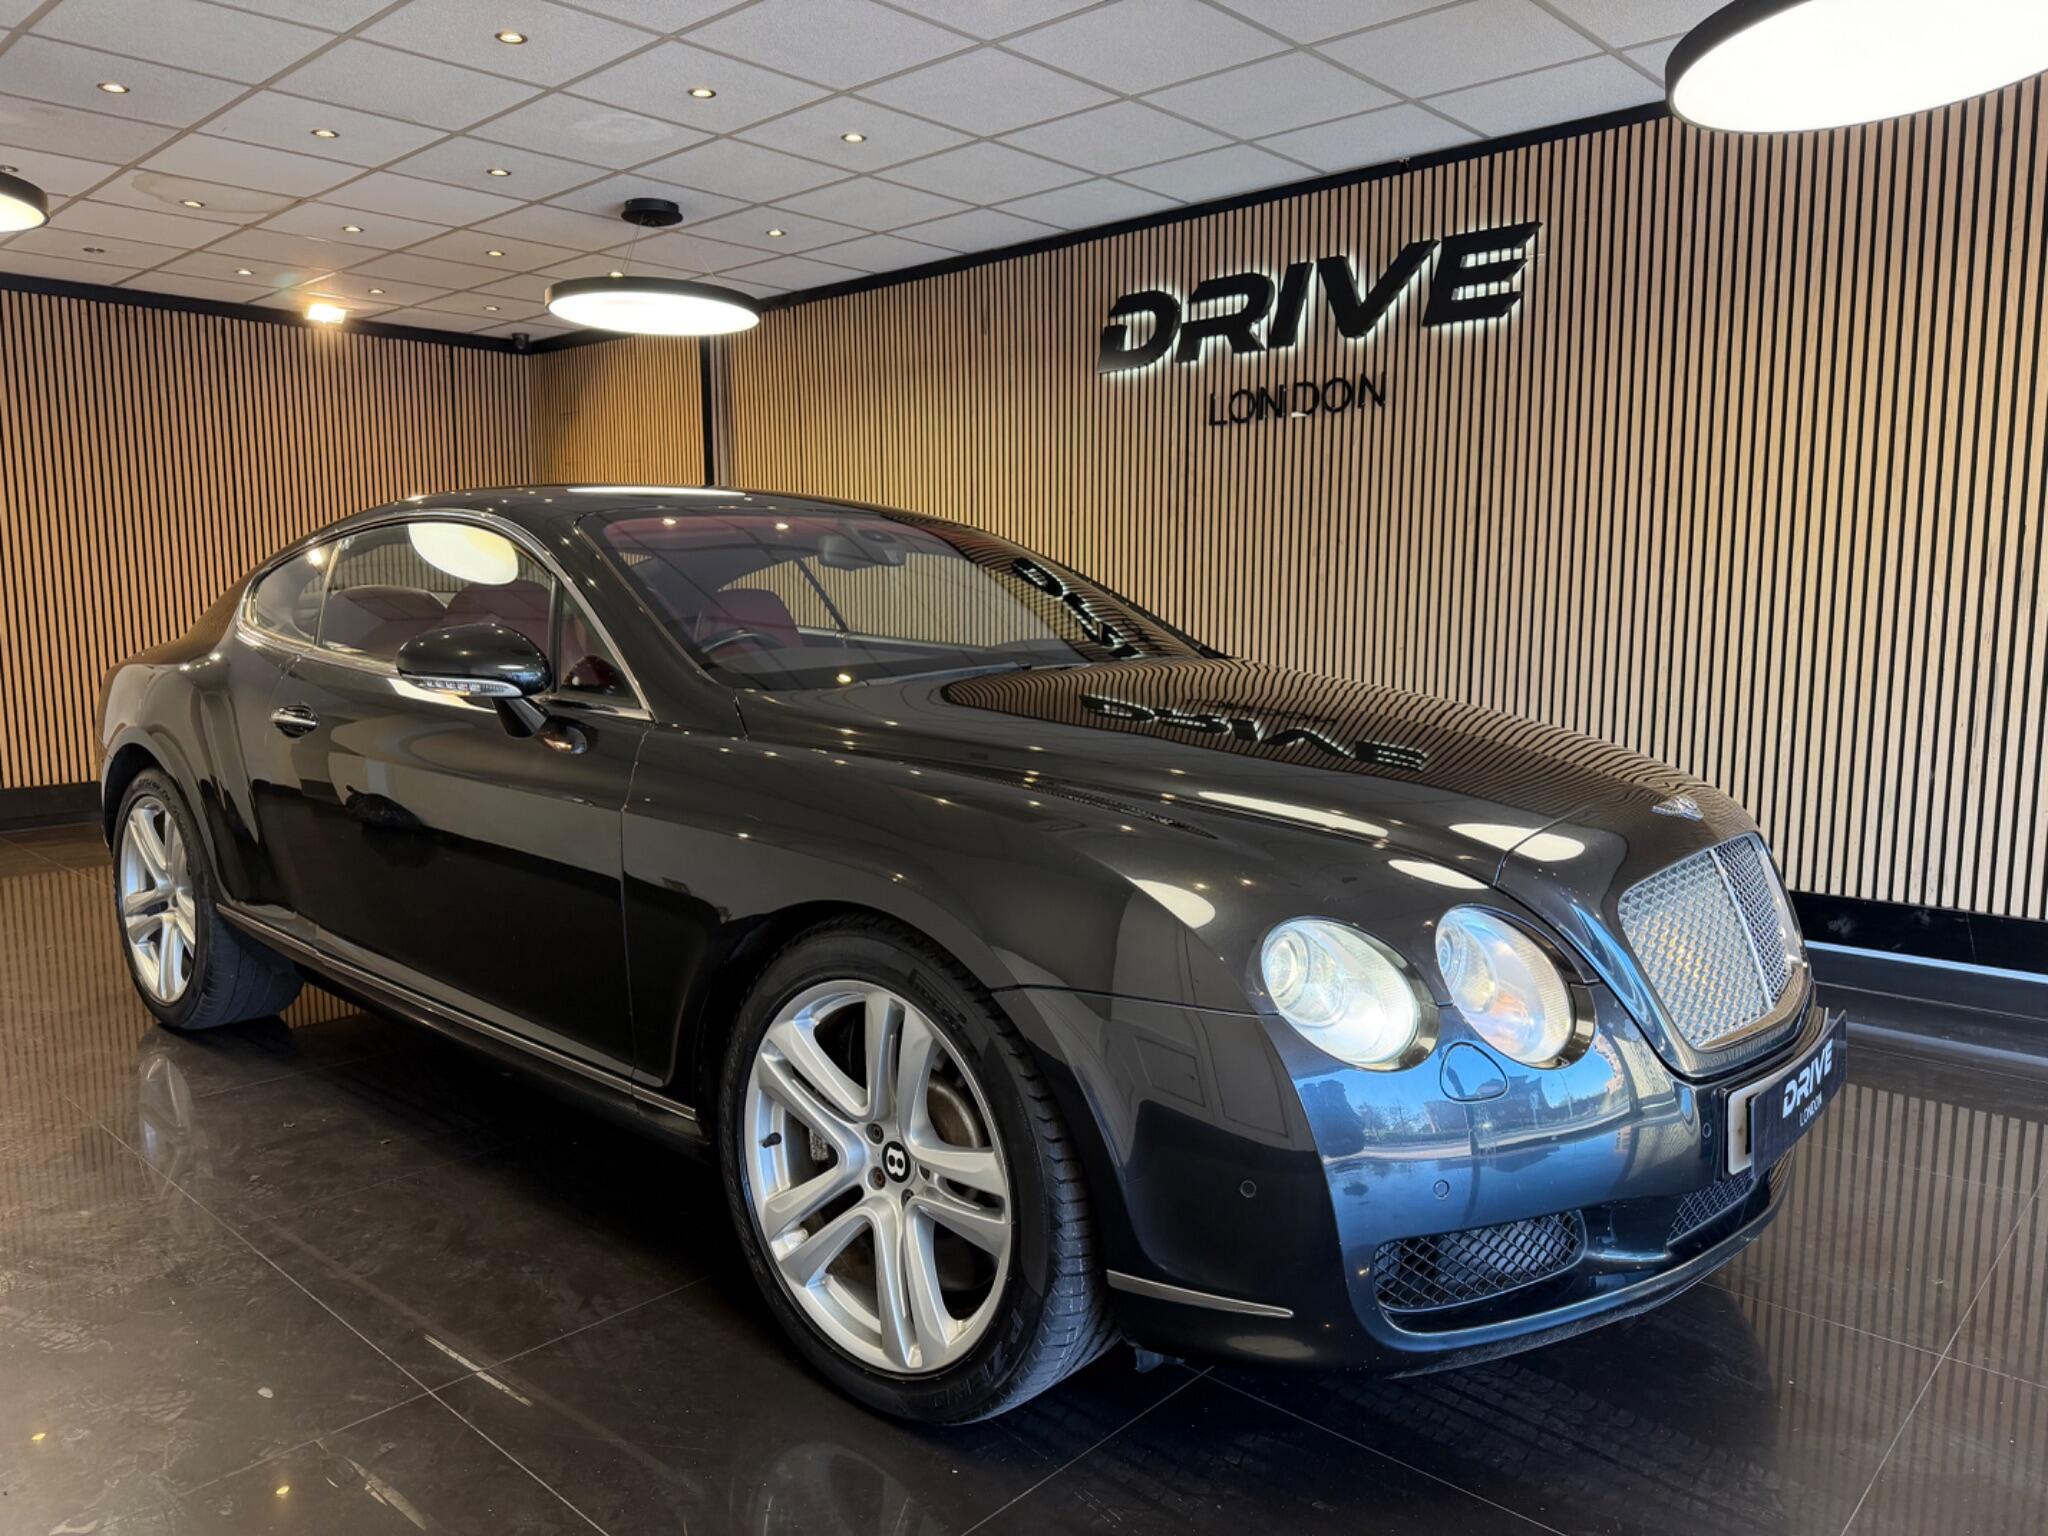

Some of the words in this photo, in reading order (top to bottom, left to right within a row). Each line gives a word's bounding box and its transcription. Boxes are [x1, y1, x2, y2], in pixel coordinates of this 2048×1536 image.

[1096, 220, 1543, 374] DRIVE
[1208, 372, 1387, 426] LONDON
[1782, 1038, 1833, 1119] DRIVE
